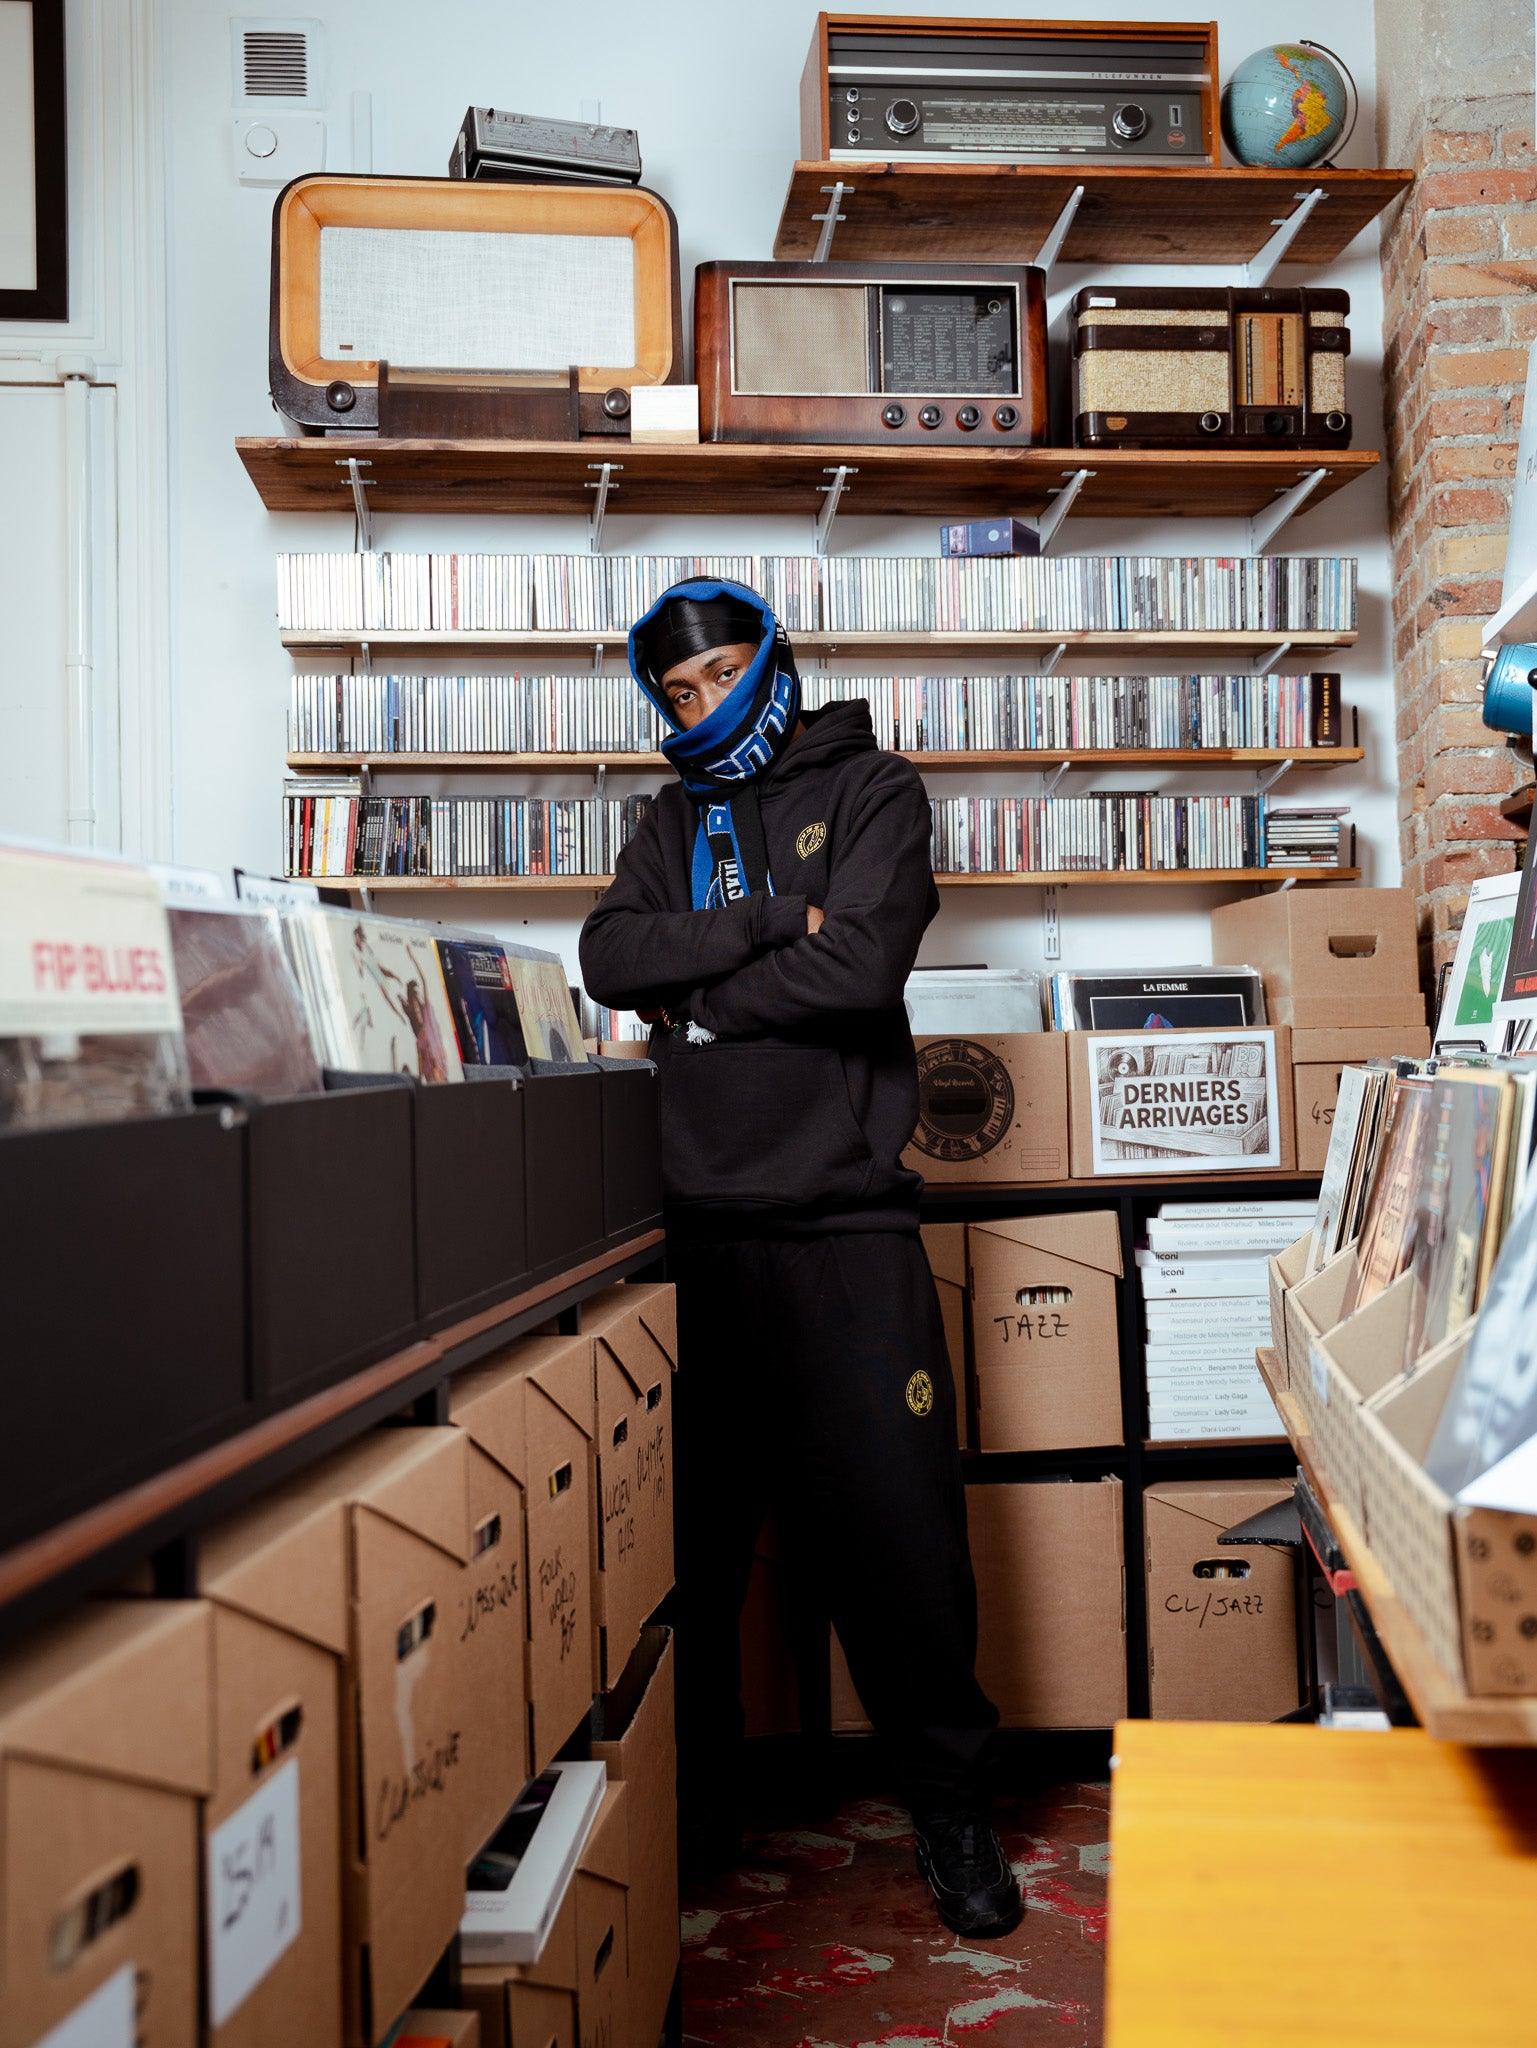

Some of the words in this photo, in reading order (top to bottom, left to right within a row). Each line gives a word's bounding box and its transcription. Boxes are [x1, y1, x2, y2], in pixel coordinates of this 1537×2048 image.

[1091, 72, 1162, 80] TELEFUNKEN
[1143, 983, 1156, 992] LA
[1156, 982, 1188, 992] FEMME
[1237, 1046, 1258, 1063] BD
[933, 1078, 951, 1088] Vinyl
[952, 1078, 976, 1087] Records
[1124, 1079, 1242, 1105] DERNIERS
[1120, 1104, 1249, 1129] ARRIVAGES
[1258, 1220, 1274, 1228] Miles
[1246, 1238, 1269, 1246] Johnny
[993, 1313, 1070, 1344] JAZZ
[1208, 1364, 1238, 1372] Benjamin
[1215, 1393, 1231, 1402] Lady
[1232, 1392, 1248, 1400] Gaga
[1214, 1408, 1230, 1416] Lady
[1231, 1408, 1248, 1416] Gaga
[604, 1473, 631, 1524] LUCIEN
[538, 1545, 565, 1603] FOLK
[549, 1571, 577, 1626] WORLD
[1164, 1592, 1264, 1628] CL/JAZZ
